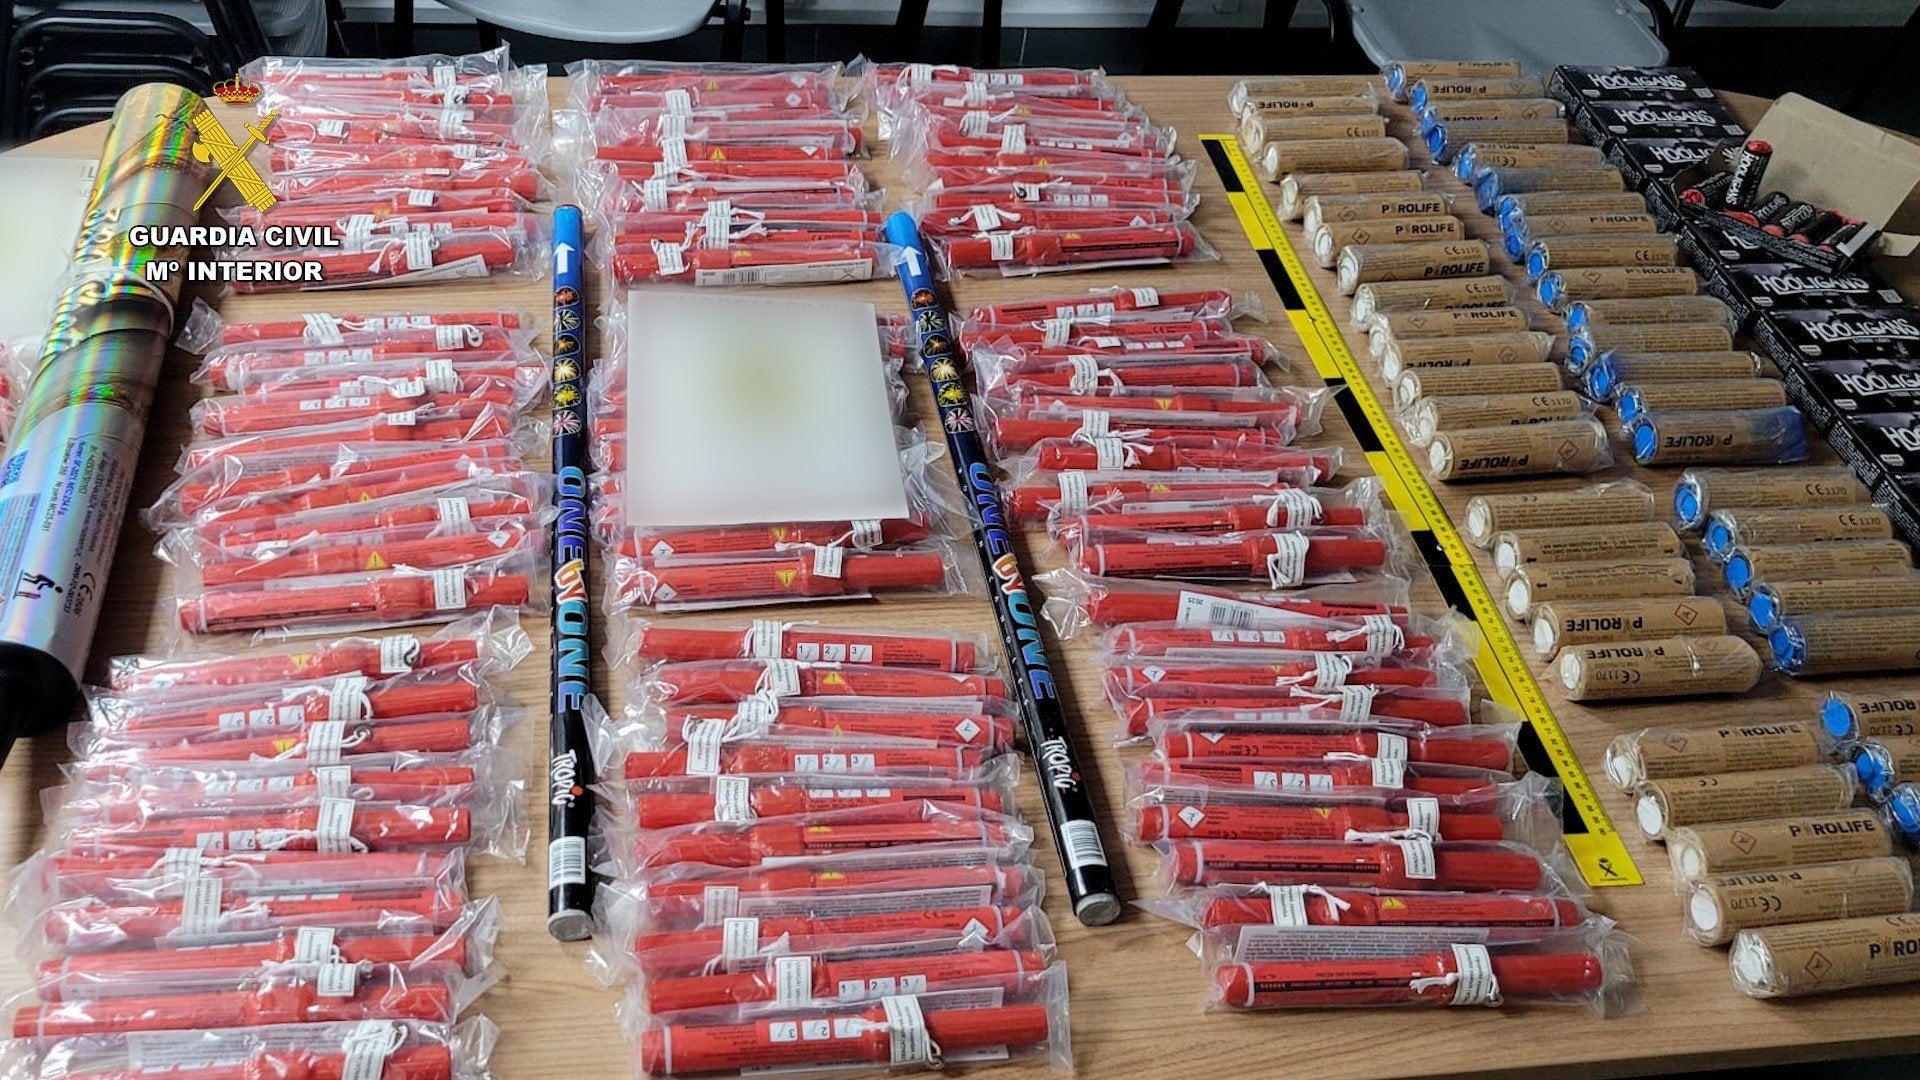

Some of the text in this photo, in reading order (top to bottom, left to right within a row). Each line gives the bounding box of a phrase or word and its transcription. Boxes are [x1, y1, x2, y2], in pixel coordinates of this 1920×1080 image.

[1587, 73, 1687, 90] HOOLIGANS
[1613, 108, 1716, 126] HOOLIGANS
[1381, 202, 1440, 213] PROLIFE
[1395, 223, 1455, 235] PROLIFE
[1423, 261, 1485, 277] PROLIFE
[1753, 273, 1869, 295] HOOLIGANS
[1801, 318, 1920, 343] HOOLIGANS
[1835, 370, 1920, 397] HOOLIGA
